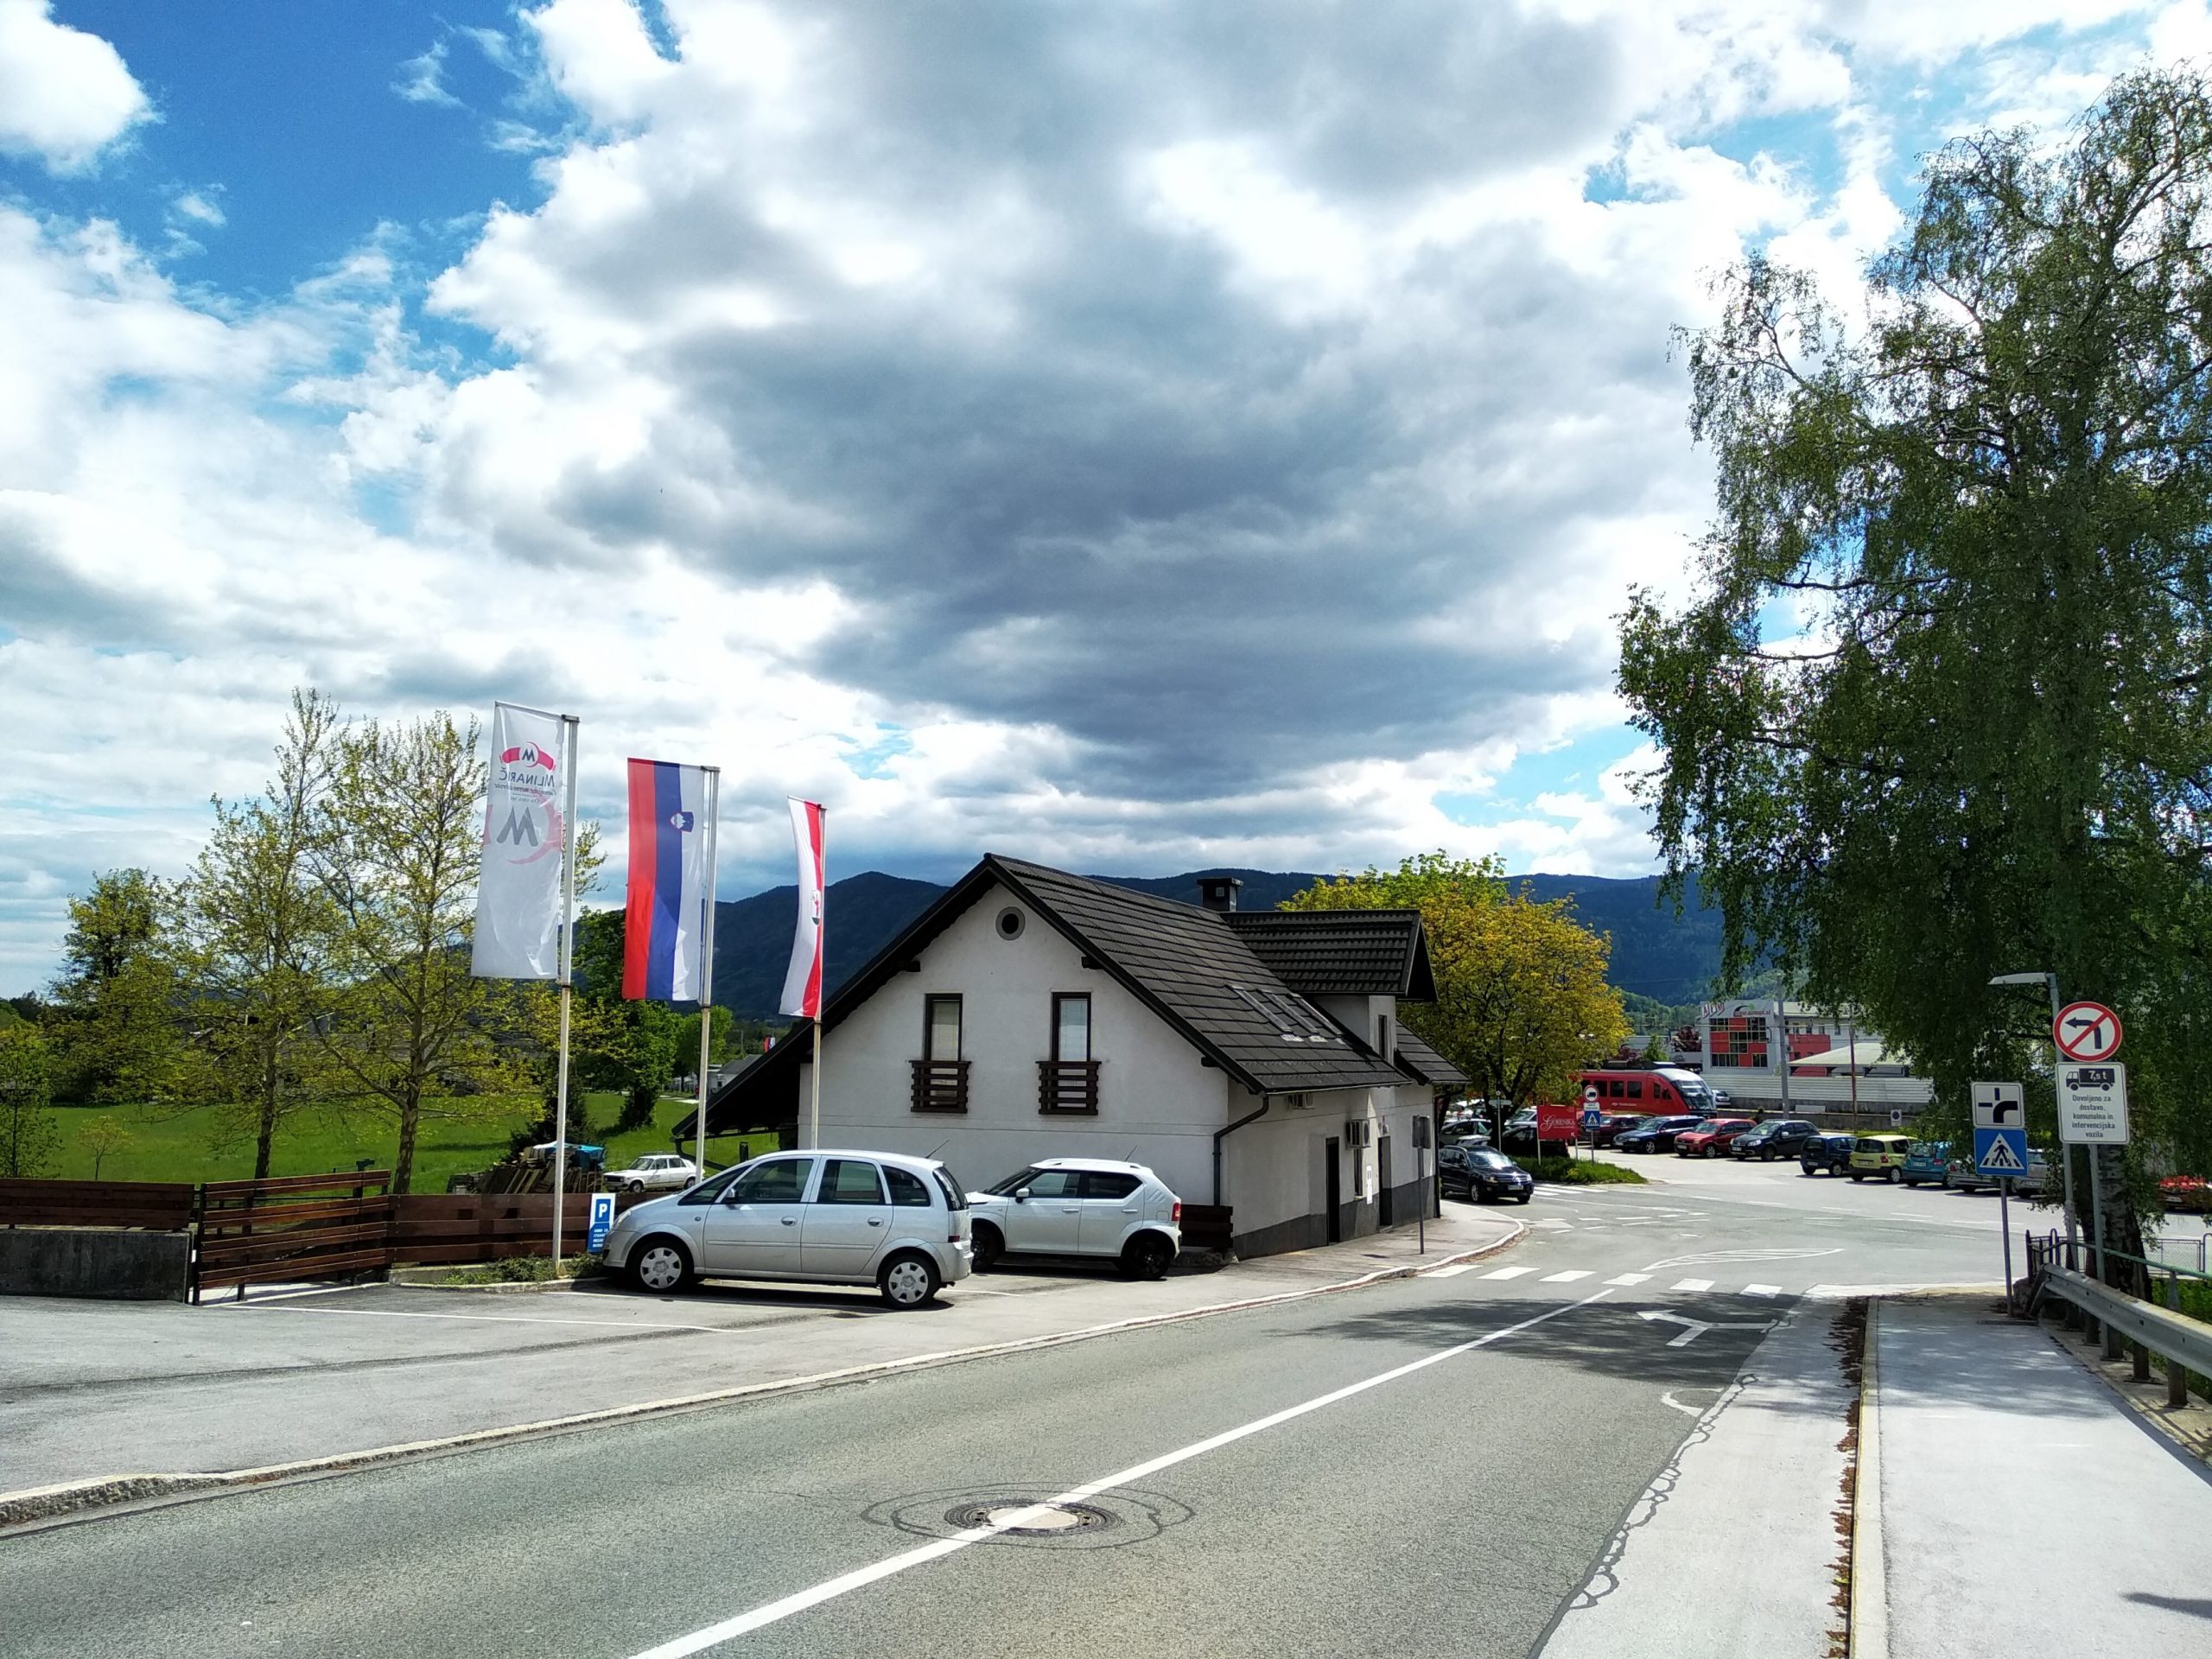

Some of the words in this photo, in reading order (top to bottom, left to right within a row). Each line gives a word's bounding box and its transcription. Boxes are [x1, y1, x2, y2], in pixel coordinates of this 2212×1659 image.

[2088, 1071, 2101, 1081] 7,5
[2102, 1071, 2107, 1080] t
[2072, 1095, 2102, 1103] Dovoljeno
[2072, 1122, 2115, 1130] intervencijska
[598, 1203, 608, 1218] P
